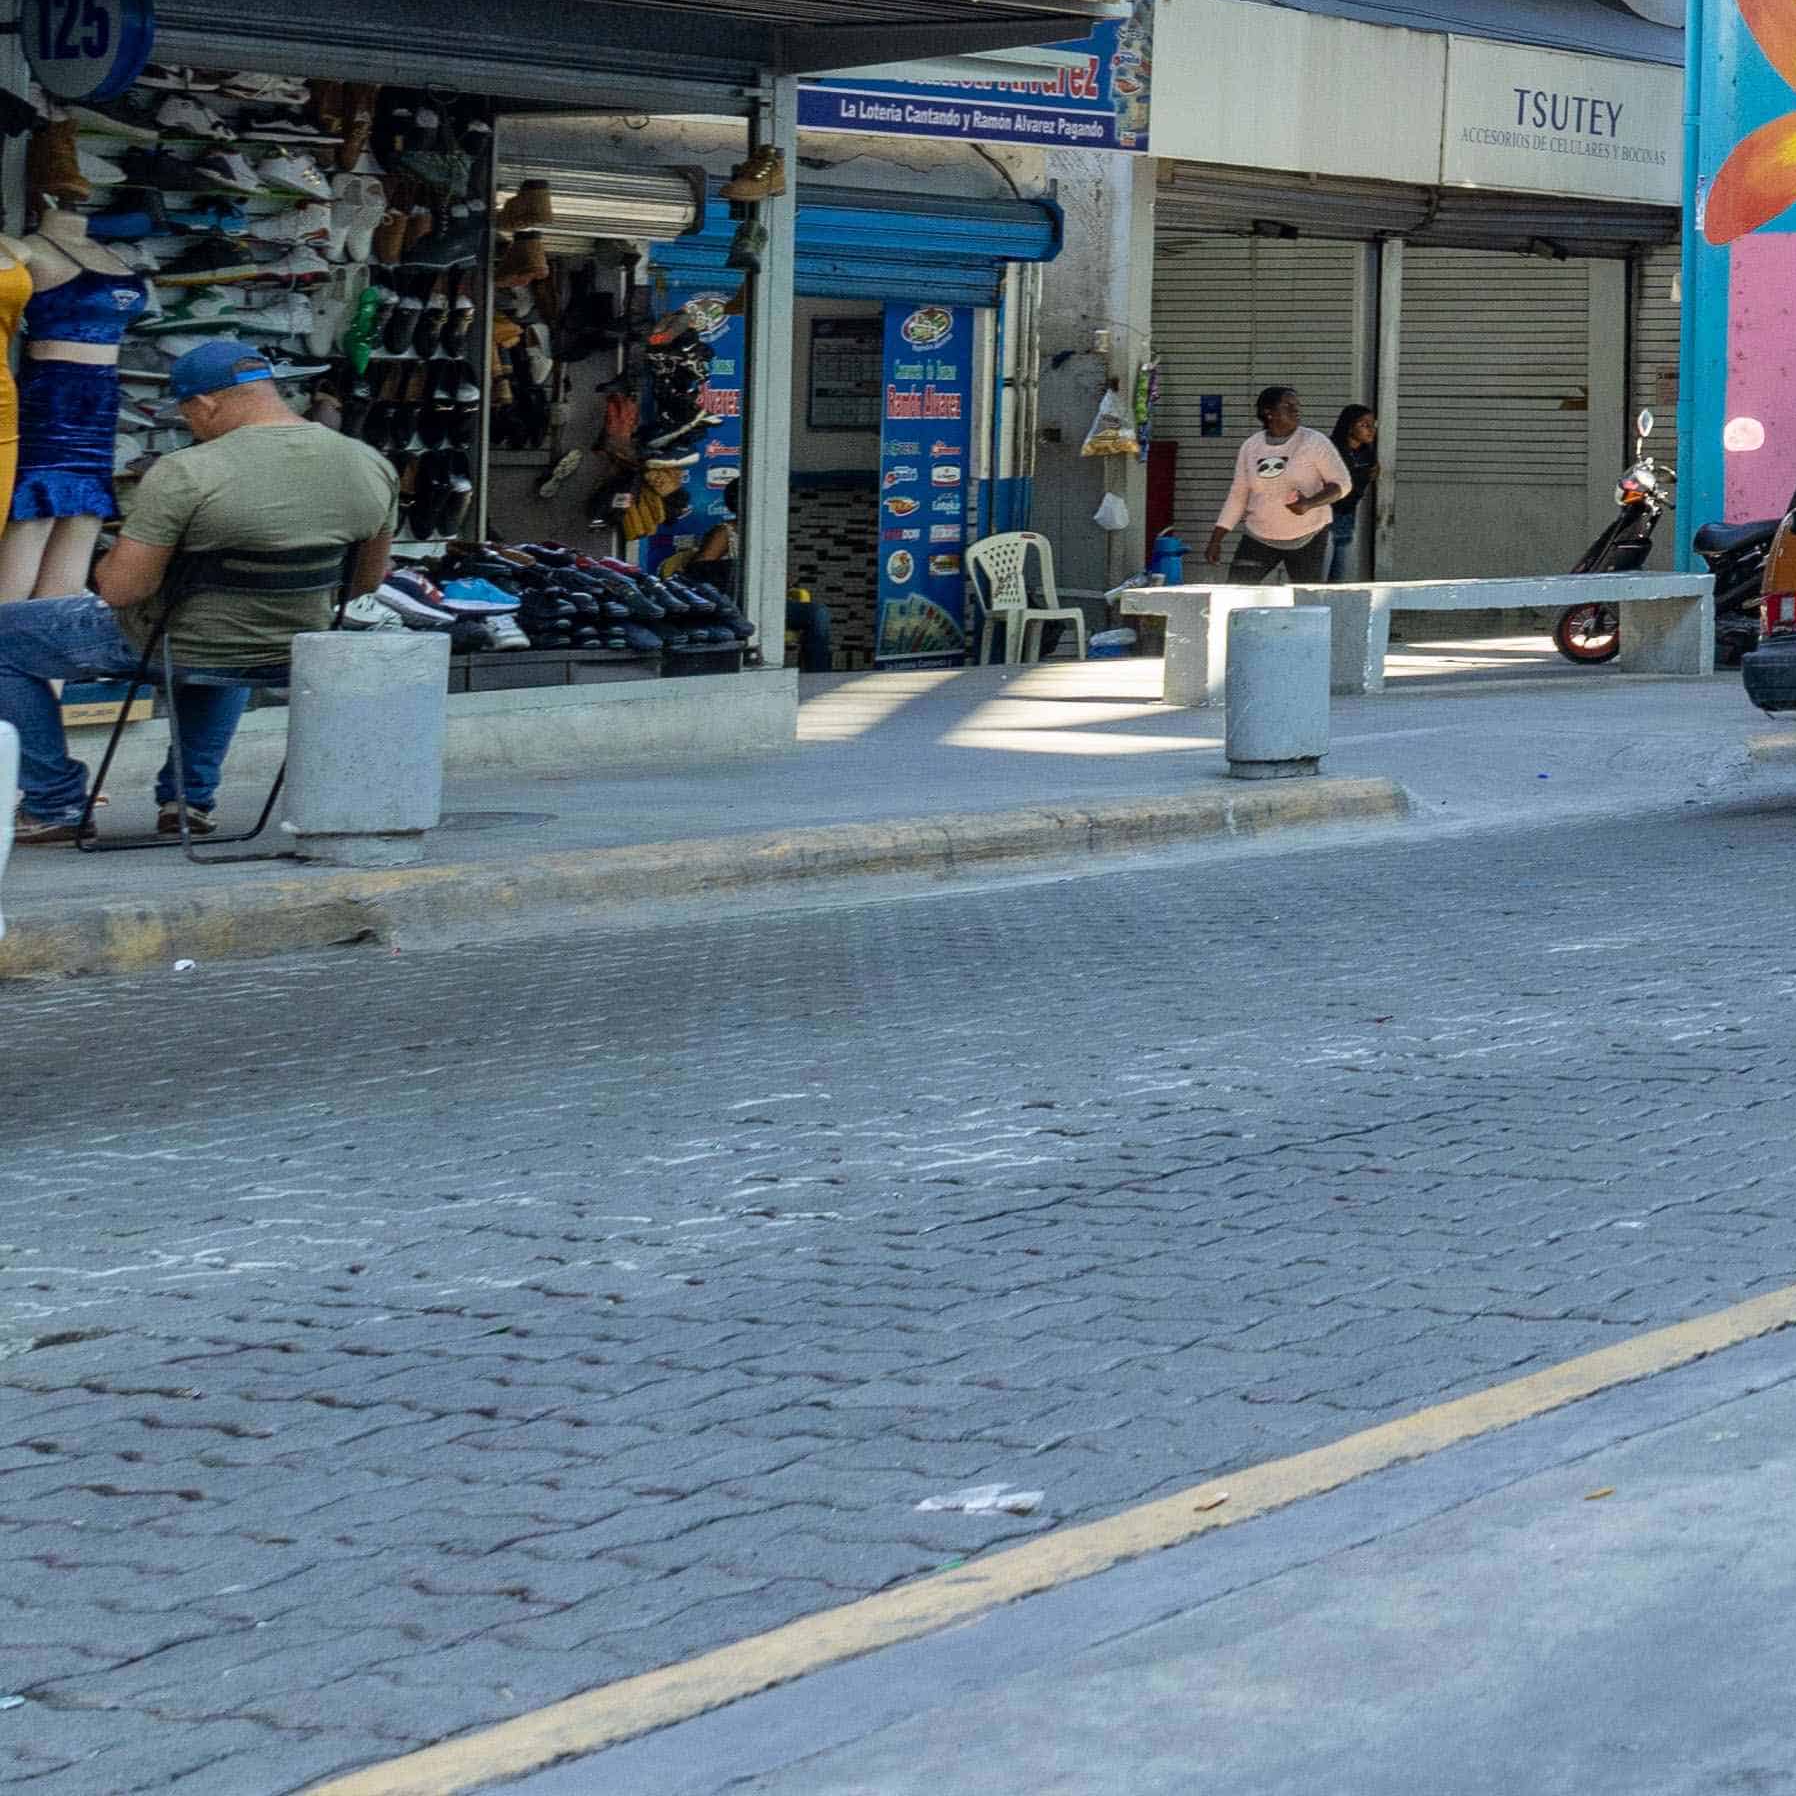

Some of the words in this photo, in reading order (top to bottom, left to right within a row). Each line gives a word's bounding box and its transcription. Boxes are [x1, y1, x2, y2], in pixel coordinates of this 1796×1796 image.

[840, 99, 857, 118] La
[904, 103, 961, 127] Cantando
[961, 113, 970, 132] y
[1013, 114, 1055, 135] Alvarez
[1057, 118, 1104, 140] Pagando
[1514, 88, 1623, 137] TSUTEY
[1461, 127, 1530, 150] ACCESORIOS
[1534, 135, 1548, 151] DE
[1550, 137, 1610, 157] CELULARES
[1611, 146, 1621, 160] Y
